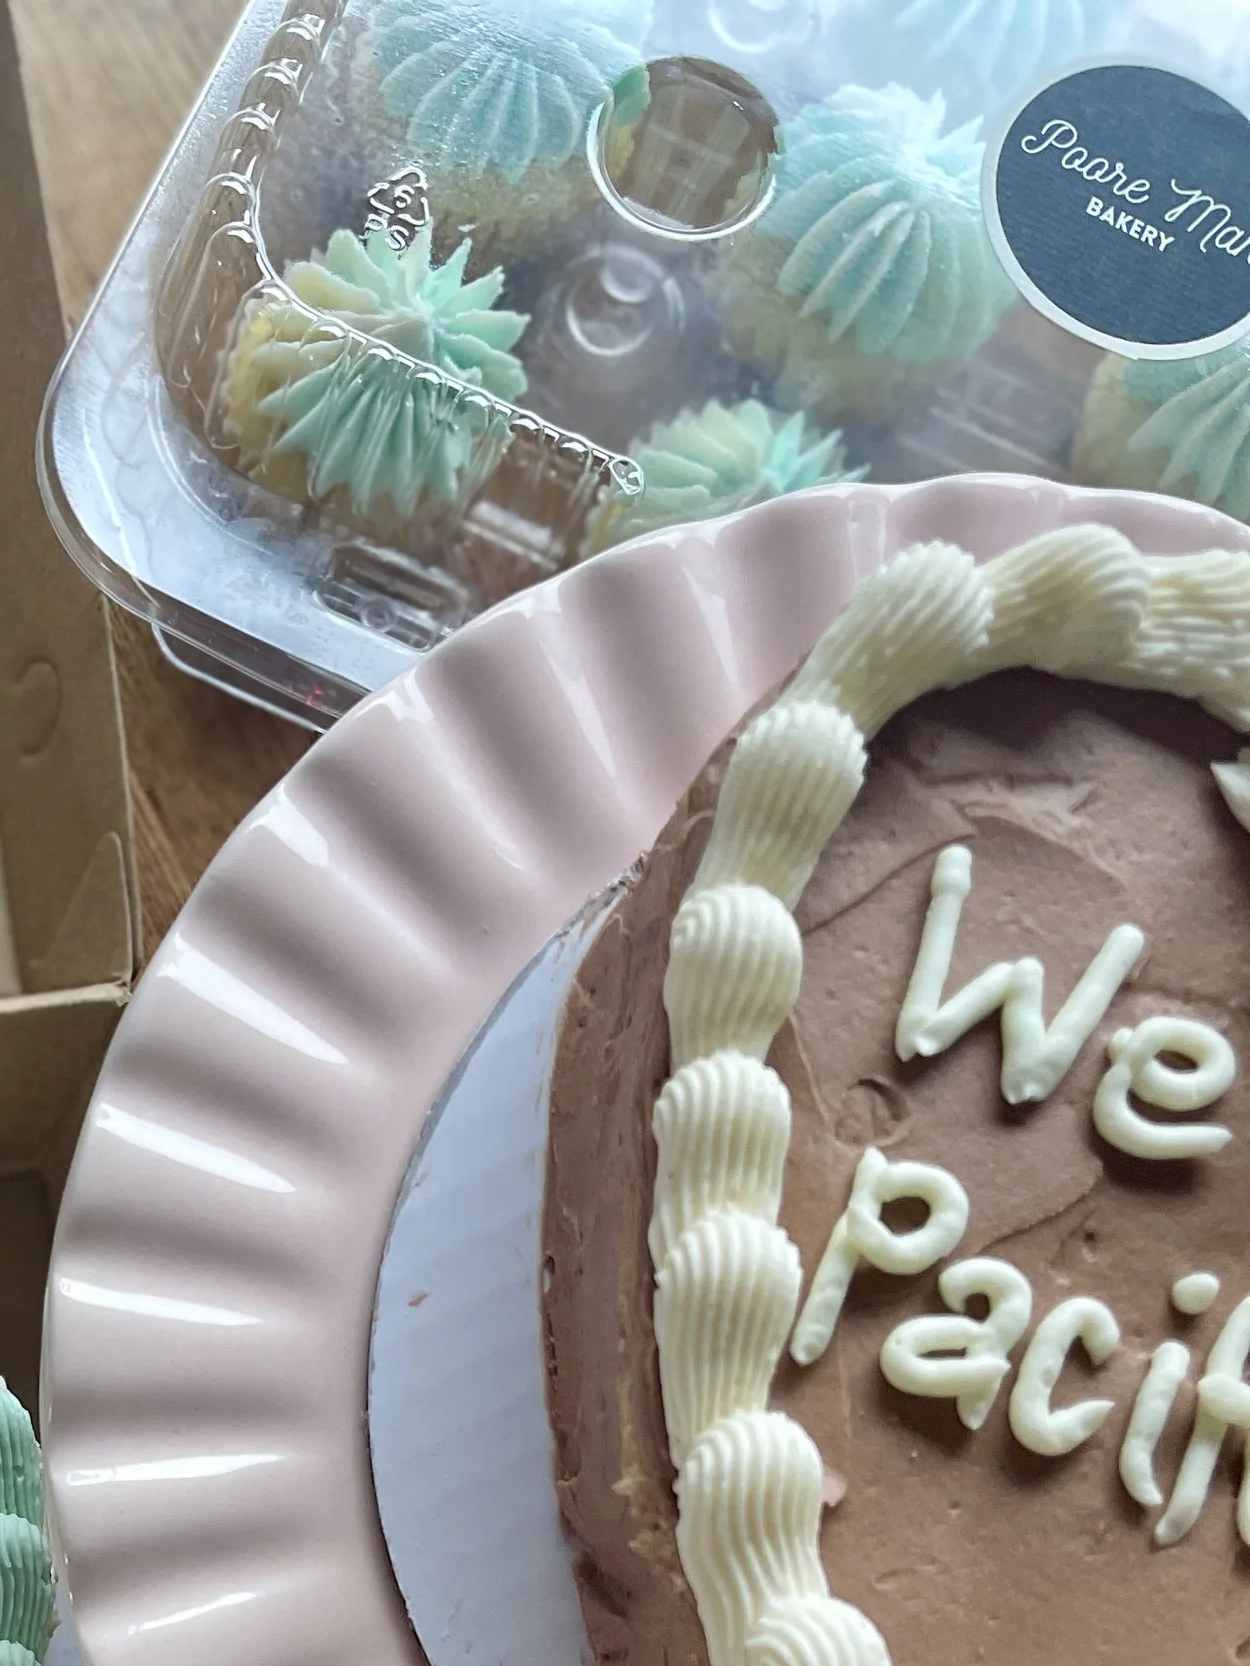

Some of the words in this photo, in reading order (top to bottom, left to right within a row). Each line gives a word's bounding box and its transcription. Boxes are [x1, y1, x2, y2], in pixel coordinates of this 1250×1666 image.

[1021, 119, 1151, 204] Poore
[1164, 178, 1250, 265] Ma
[1085, 196, 1175, 252] BAKERY
[895, 844, 1236, 1160] We
[790, 1146, 1250, 1546] Pacif
